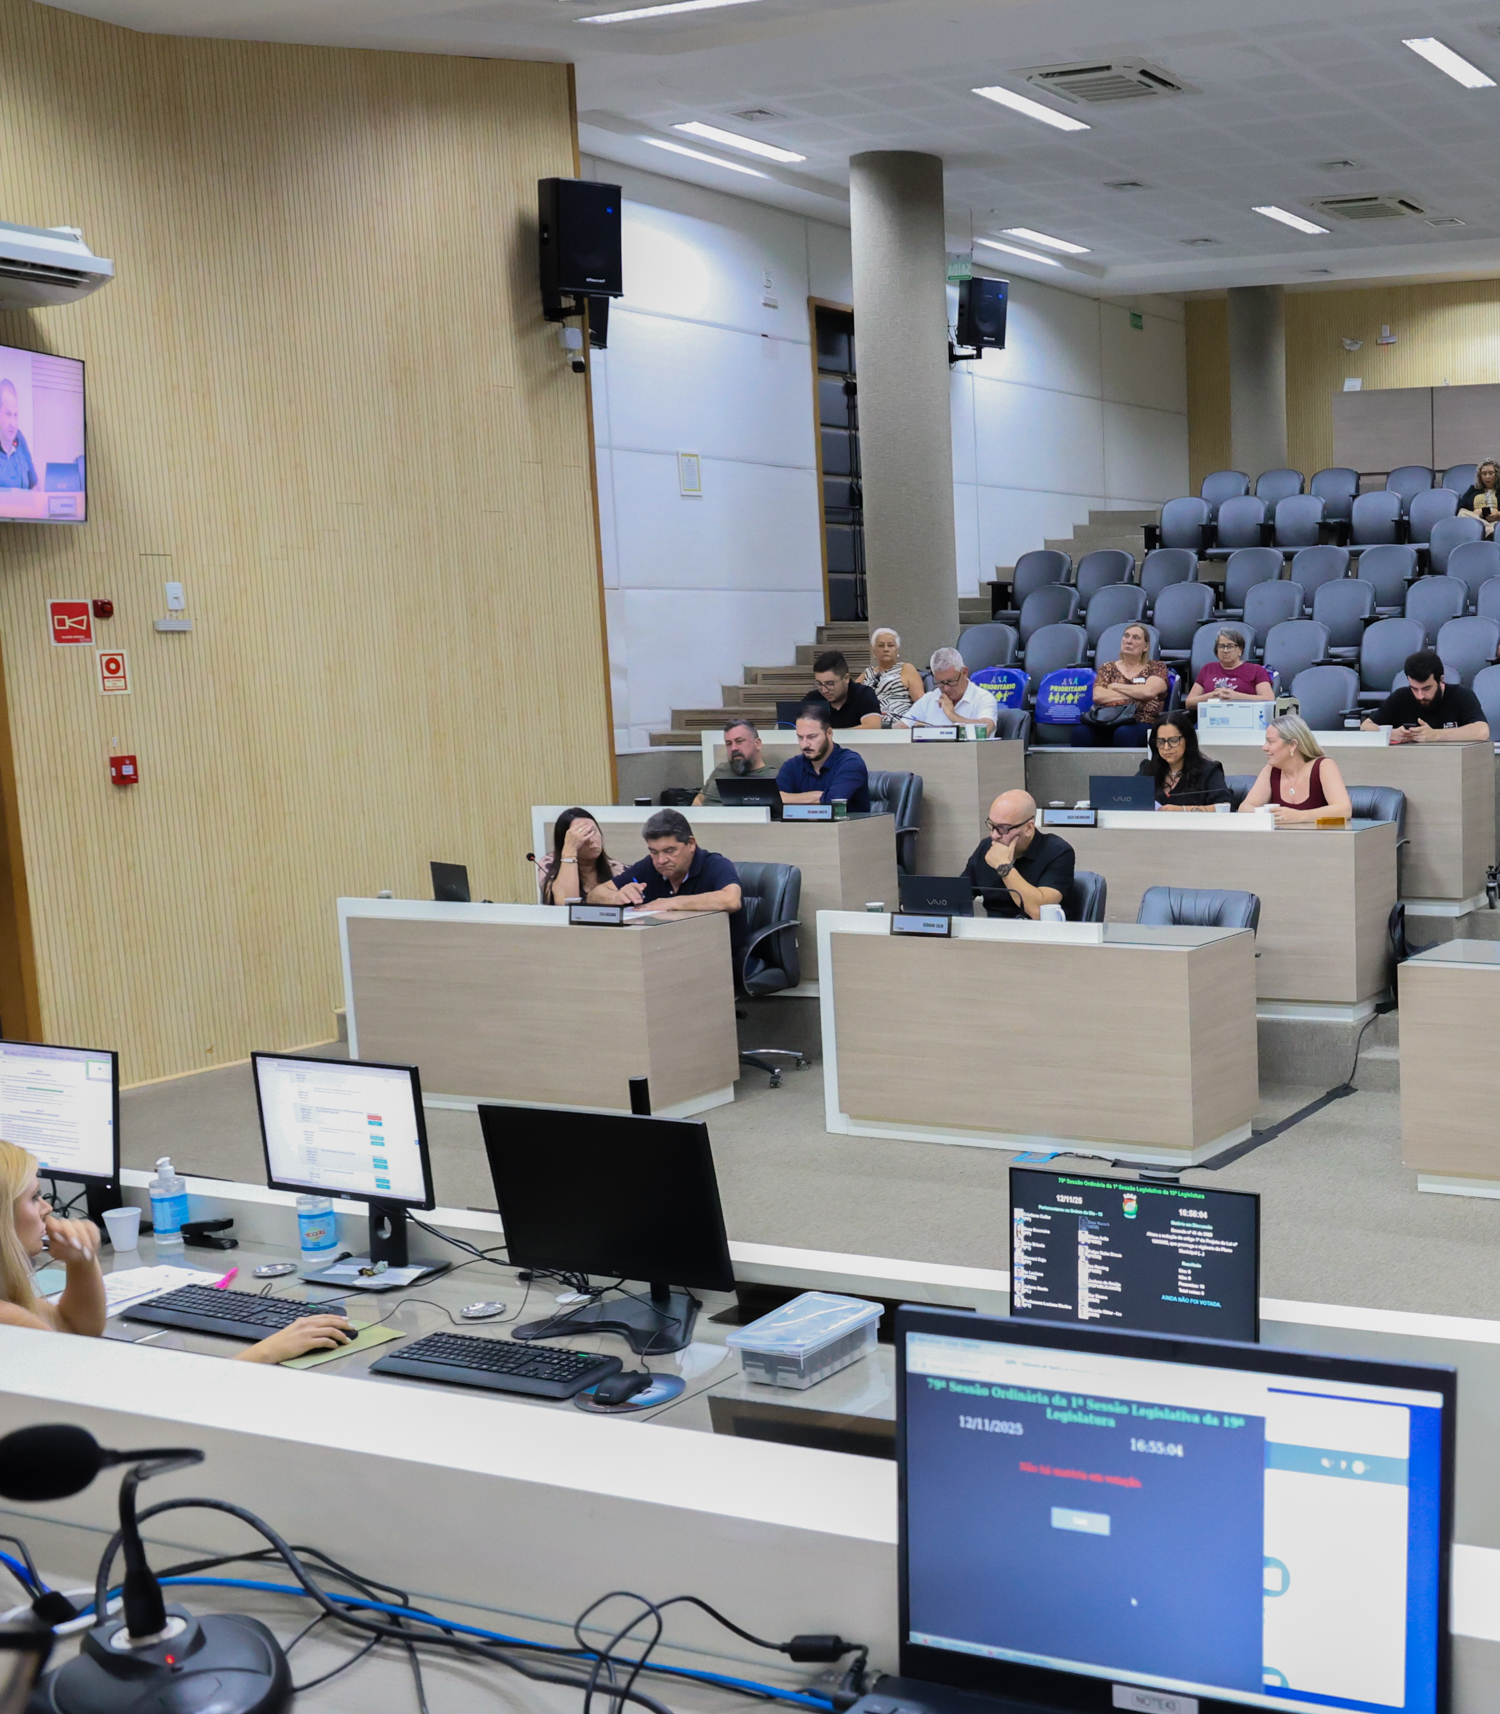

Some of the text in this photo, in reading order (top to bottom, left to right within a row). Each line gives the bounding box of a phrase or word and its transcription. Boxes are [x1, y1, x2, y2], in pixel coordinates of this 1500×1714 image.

[926, 898, 948, 906] VAIO
[1161, 1294, 1178, 1302] AINDA
[1177, 1296, 1190, 1304] NÃO
[1199, 1299, 1223, 1308] VOTADA.
[948, 1380, 990, 1397] Sessão
[990, 1385, 1050, 1405] Ordinária
[1051, 1393, 1068, 1407] da
[1086, 1398, 1130, 1415] Sessão
[1131, 1403, 1201, 1424] Legislativa
[1202, 1412, 1219, 1427] da
[959, 1414, 1024, 1436] 12/11/2025
[1045, 1407, 1116, 1428] Legislatura
[1130, 1437, 1184, 1458] 16:55:04
